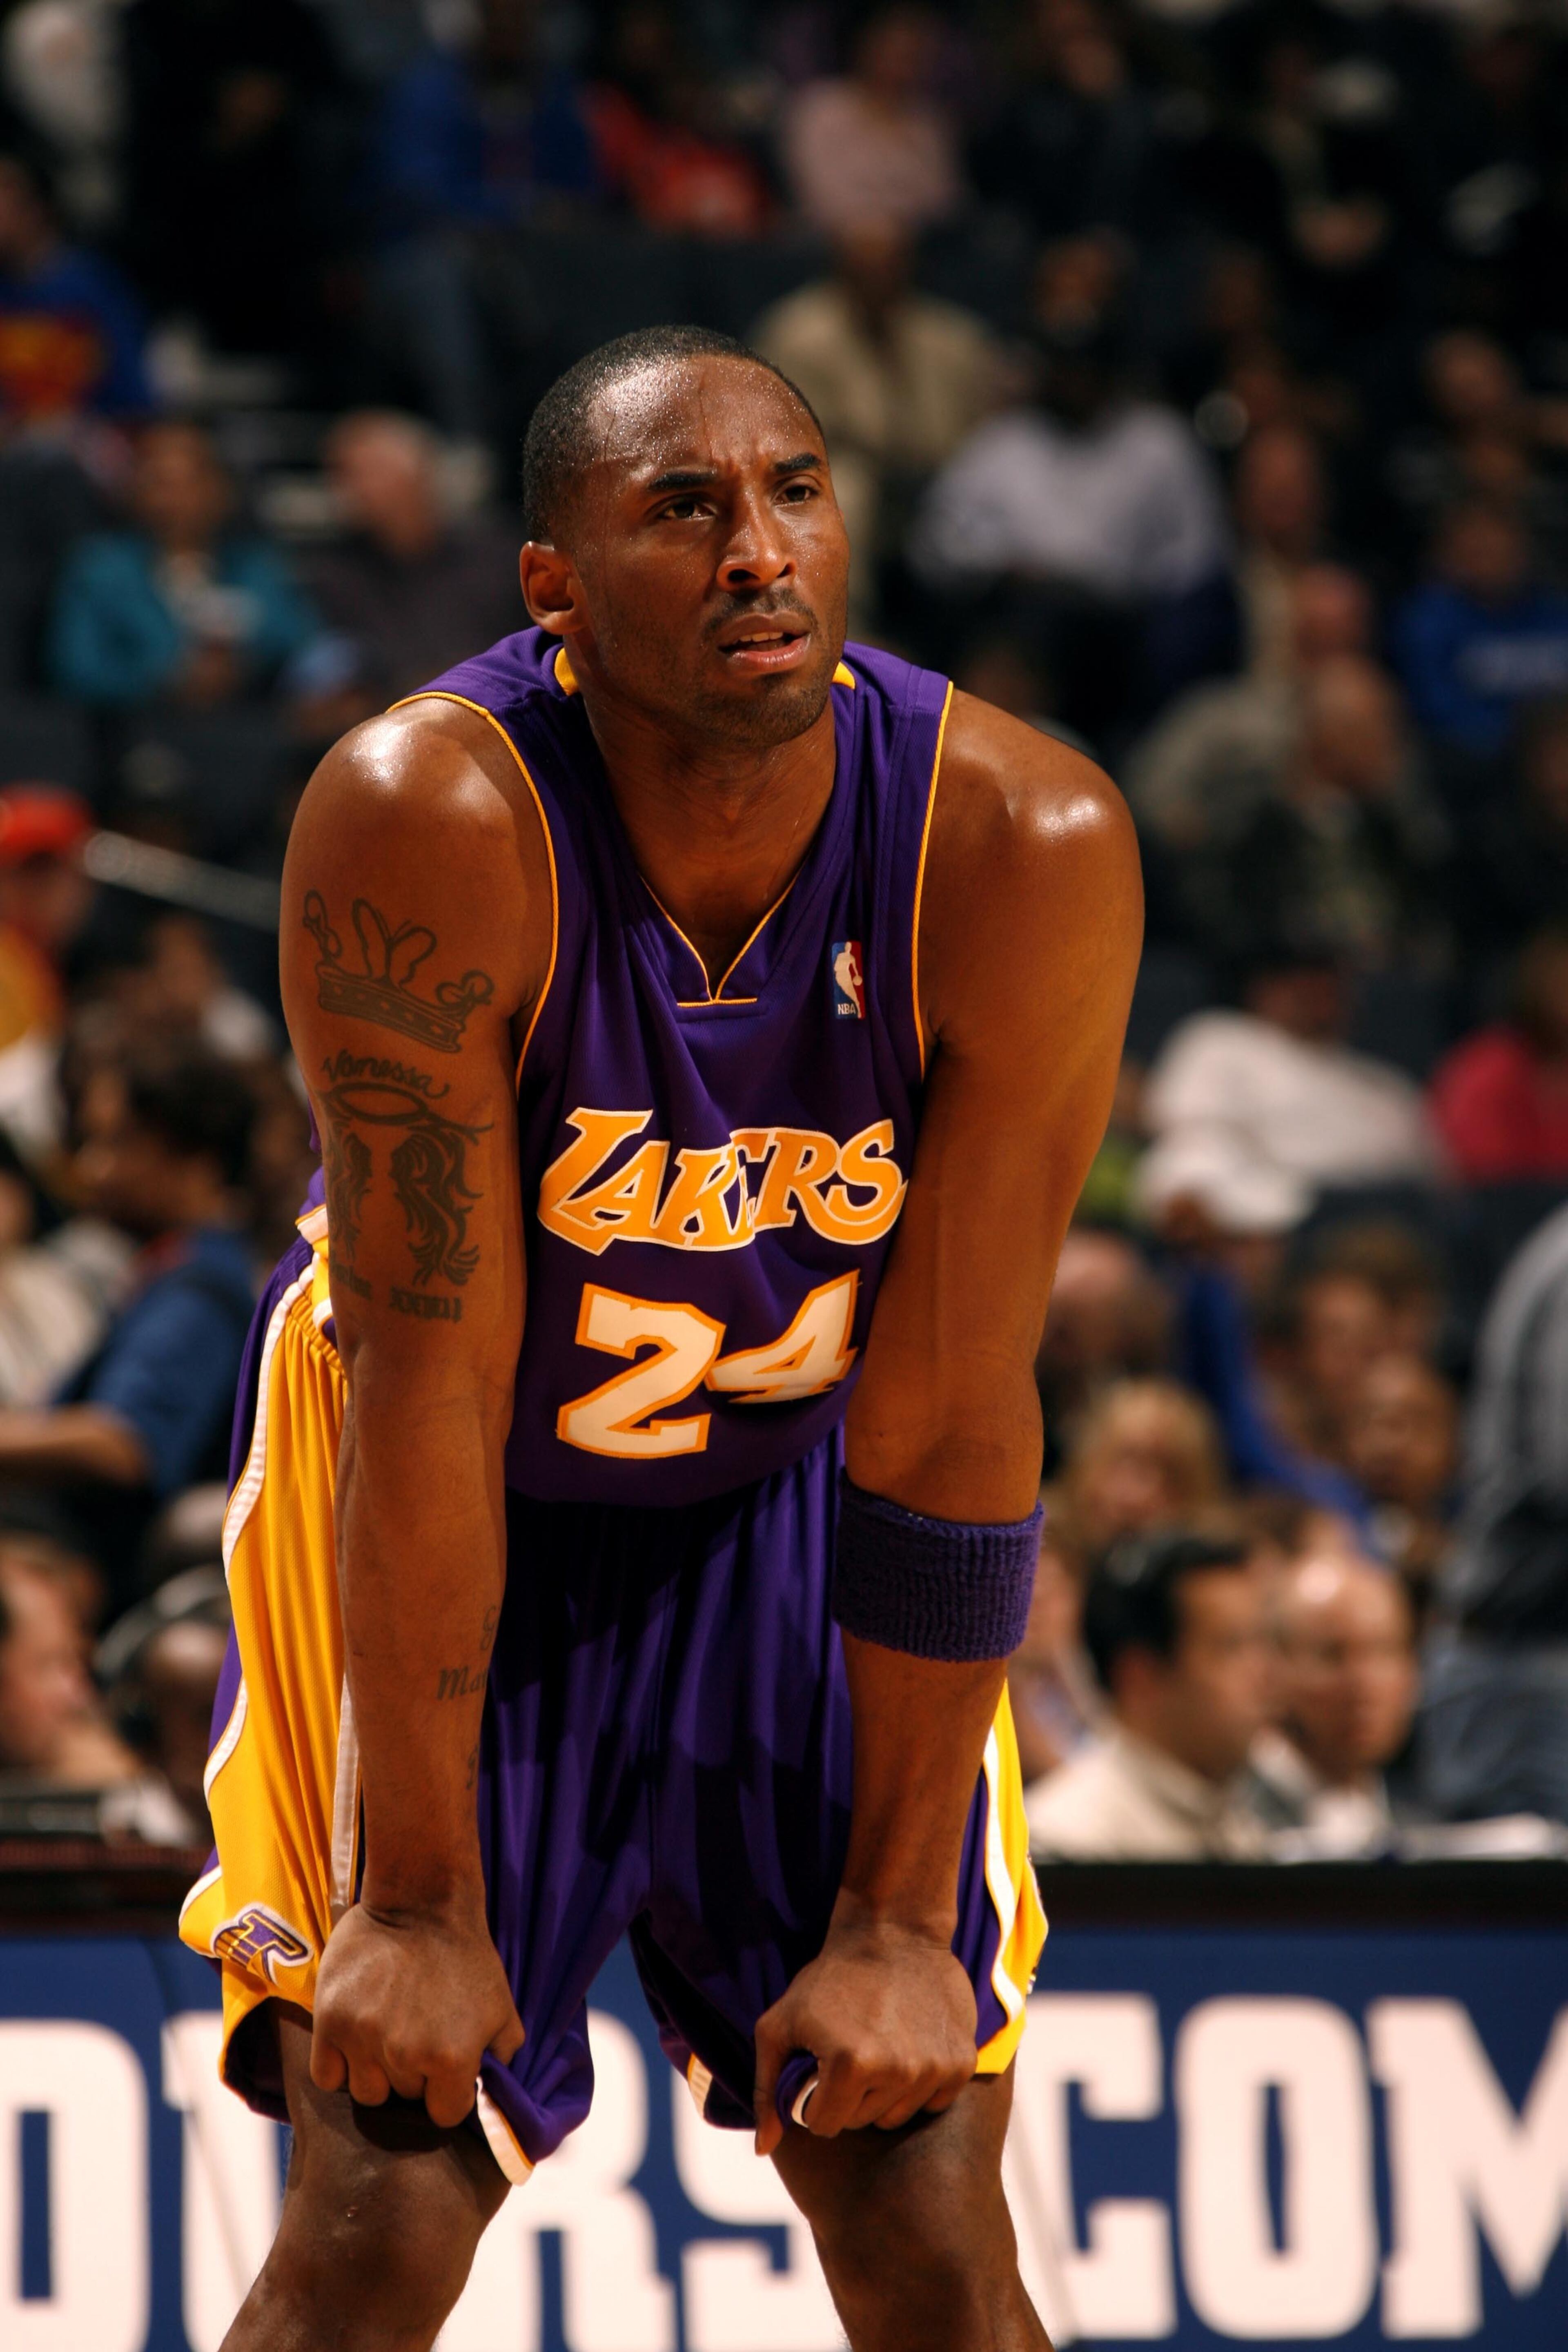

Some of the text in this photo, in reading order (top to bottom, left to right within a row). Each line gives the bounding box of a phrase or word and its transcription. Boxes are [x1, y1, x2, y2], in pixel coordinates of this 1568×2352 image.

[838, 1002, 856, 1015] NBA
[537, 1107, 909, 1256] LAKERS
[557, 1268, 860, 1459] 24
